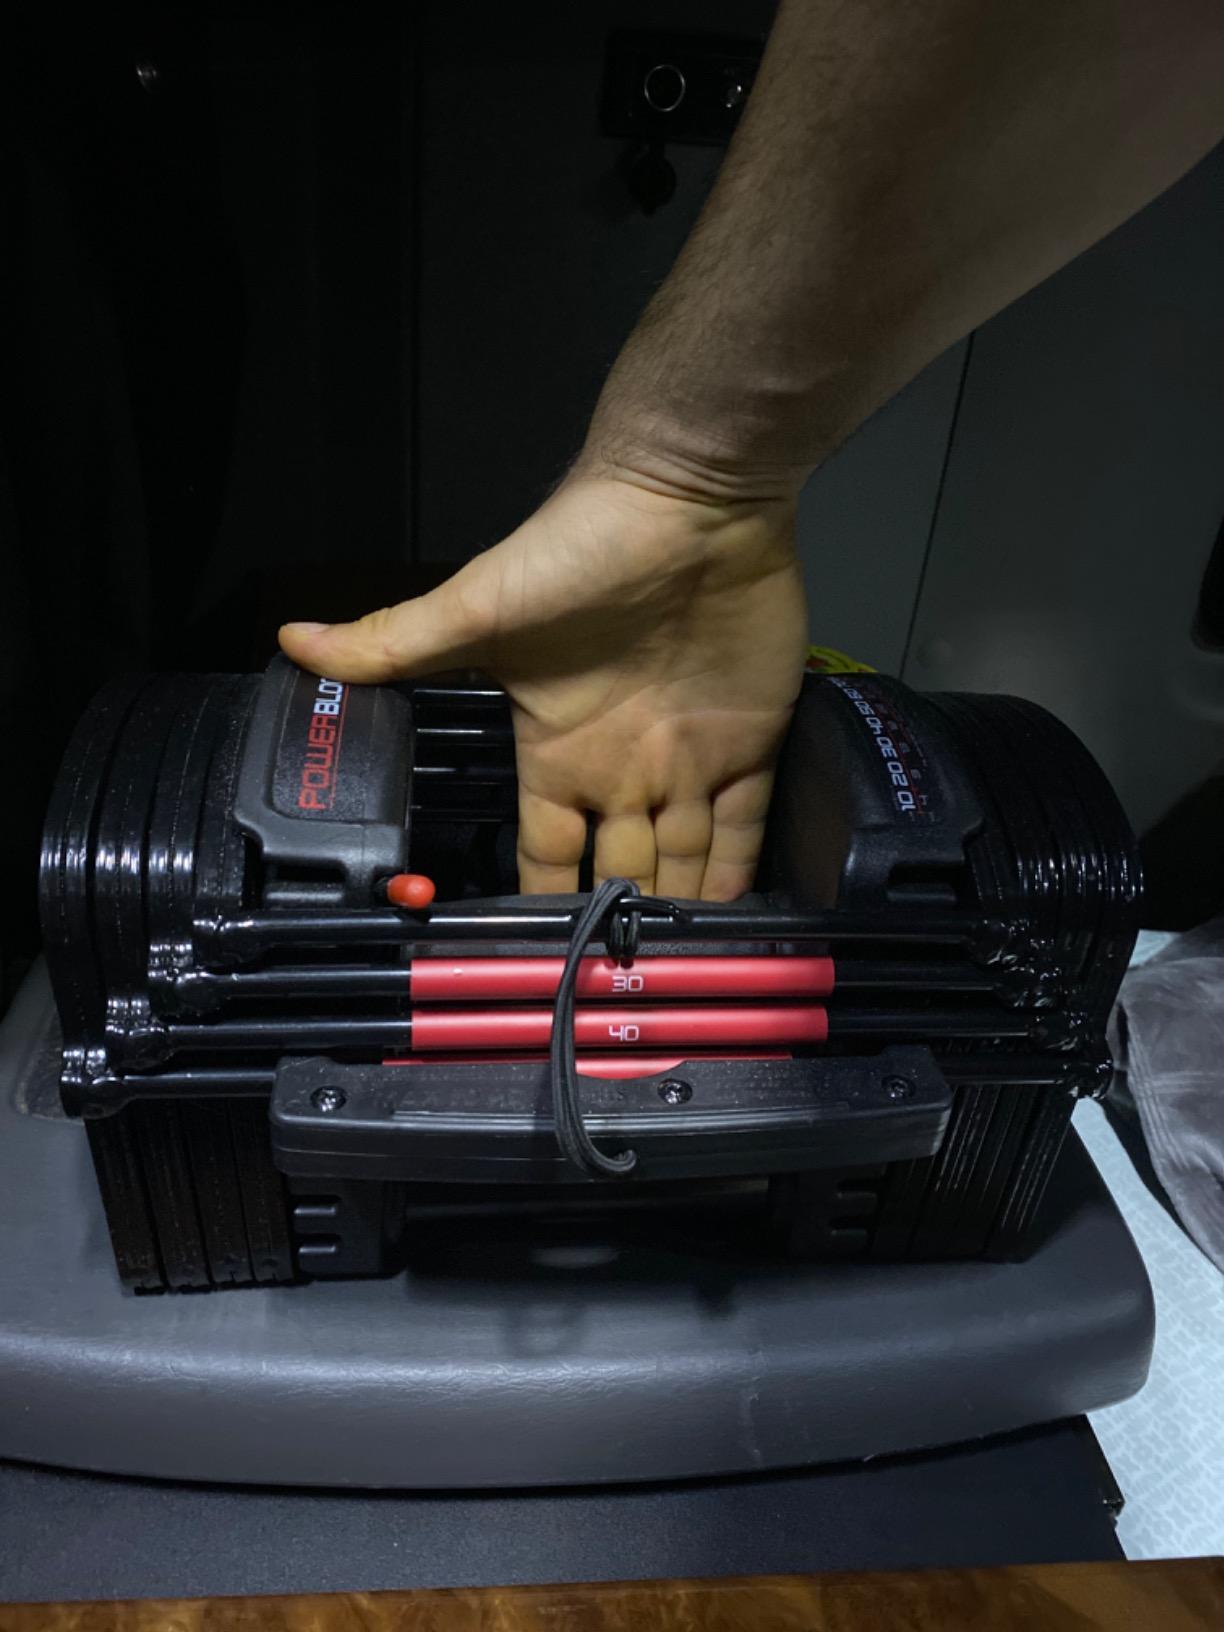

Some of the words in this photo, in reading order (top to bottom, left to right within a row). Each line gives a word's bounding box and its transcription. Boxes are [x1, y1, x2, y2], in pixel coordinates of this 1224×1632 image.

[865, 716, 884, 735] 40
[297, 677, 344, 810] POWERBLO
[876, 736, 898, 758] 30
[887, 762, 908, 787] 20
[897, 790, 917, 811] 10
[612, 975, 644, 992] 30
[608, 1024, 640, 1042] 40
